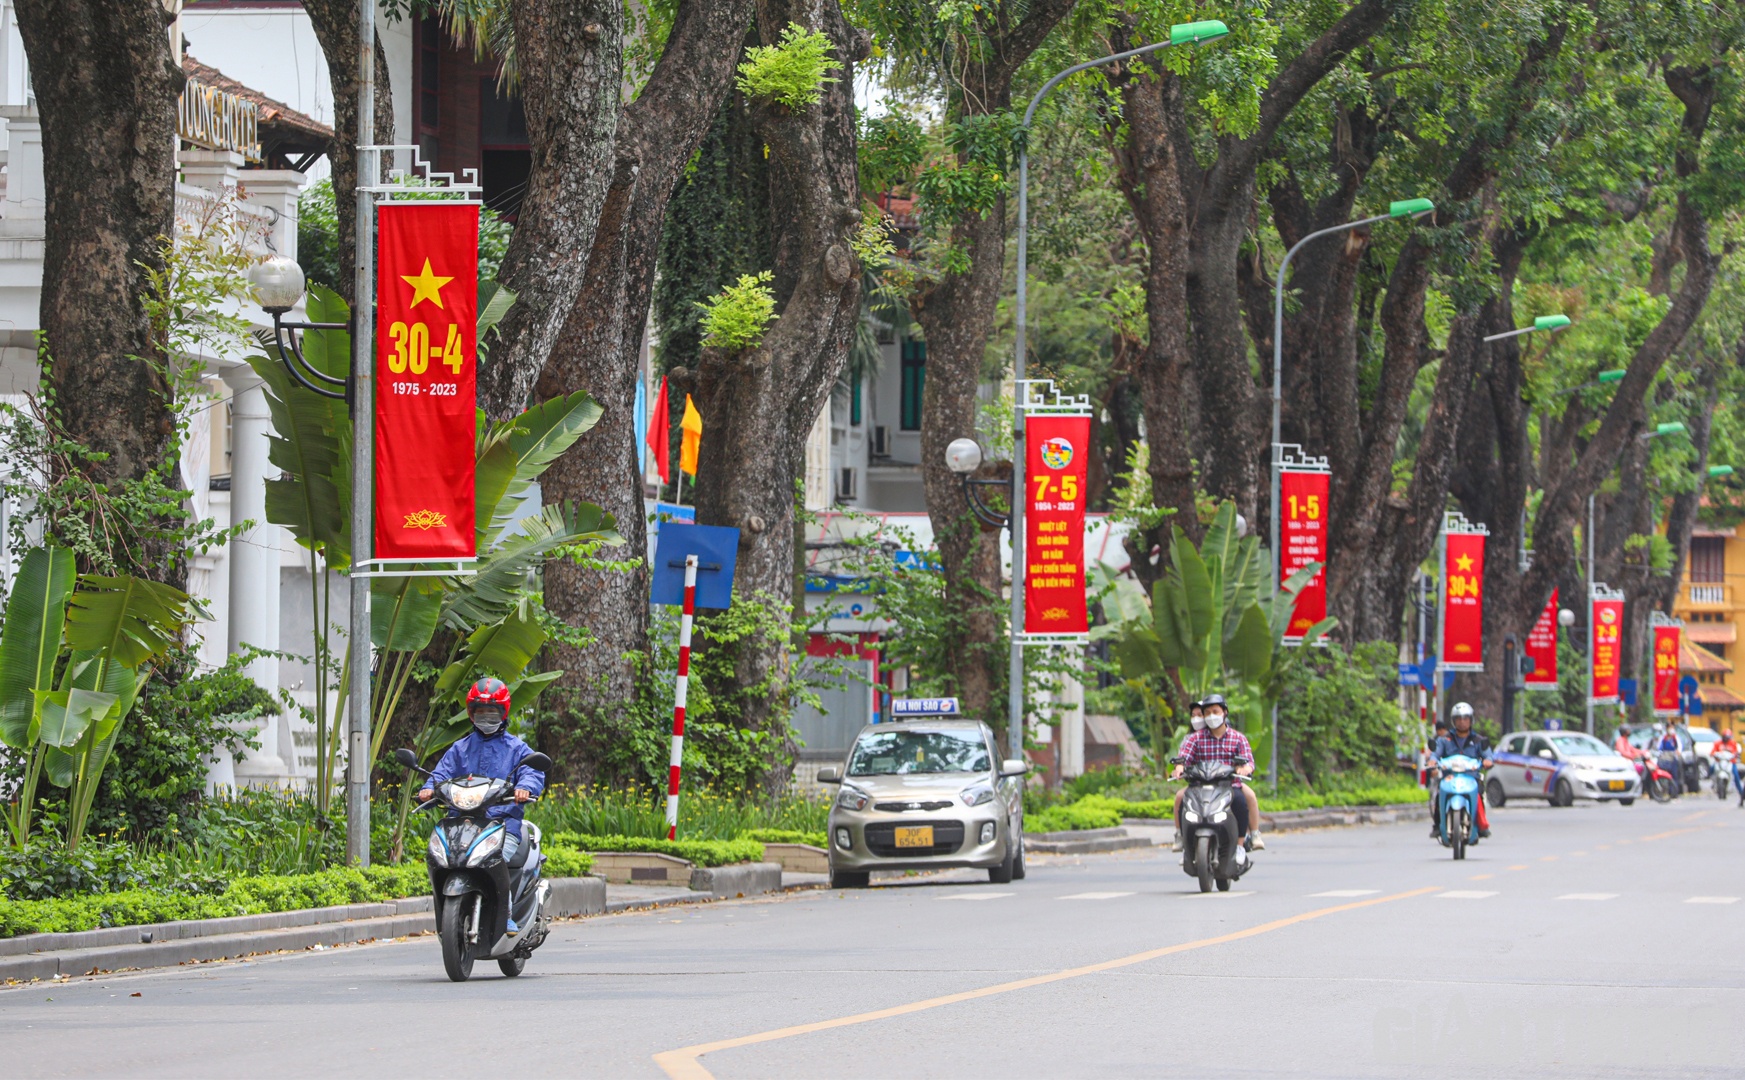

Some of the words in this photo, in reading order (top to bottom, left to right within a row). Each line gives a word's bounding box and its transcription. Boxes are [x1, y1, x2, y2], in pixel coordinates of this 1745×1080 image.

[221, 91, 261, 162] HOTEL
[388, 321, 464, 375] 30-4
[392, 382, 420, 395] 1975
[429, 383, 457, 396] 2023
[1033, 475, 1078, 501] 7-5
[1287, 495, 1320, 520] 1-5
[1449, 575, 1478, 597] 30-4
